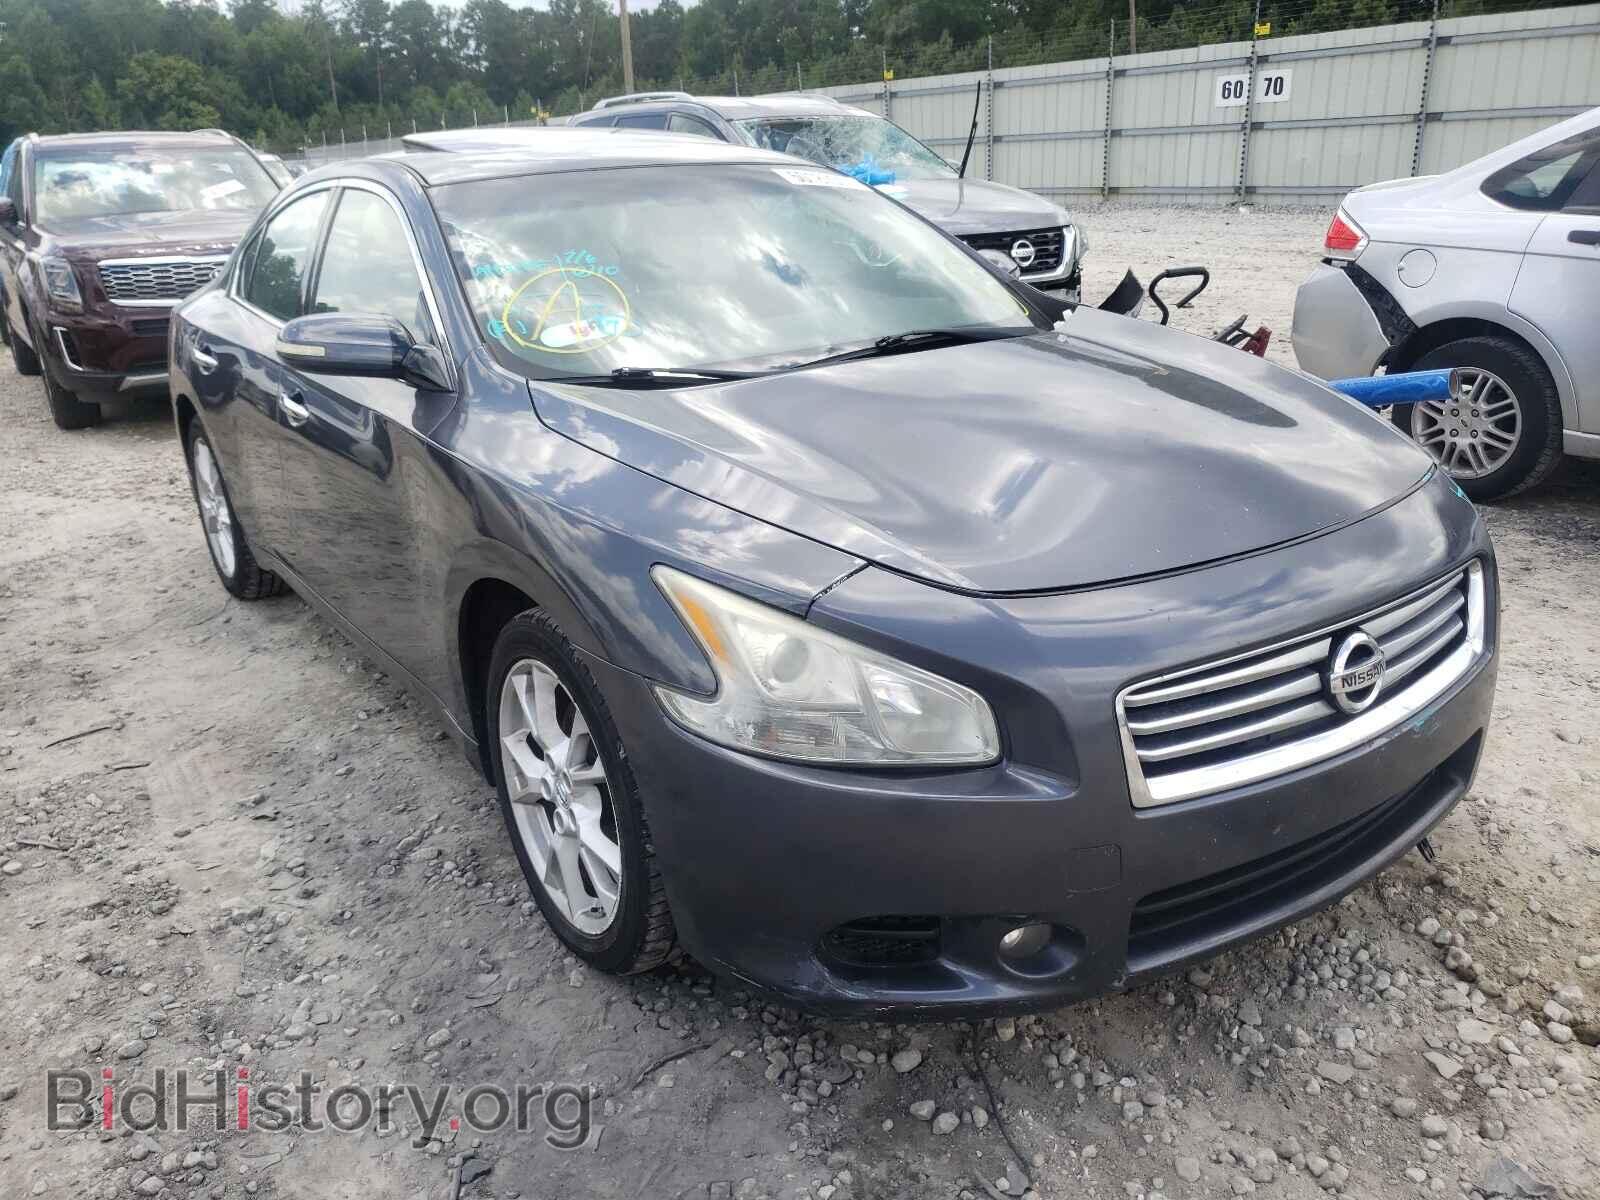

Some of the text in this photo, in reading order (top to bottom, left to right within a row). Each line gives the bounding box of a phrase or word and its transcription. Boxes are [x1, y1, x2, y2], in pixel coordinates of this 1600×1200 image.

[1222, 80, 1243, 99] 60
[1264, 76, 1284, 96] 70
[1341, 661, 1385, 689] NISSAN
